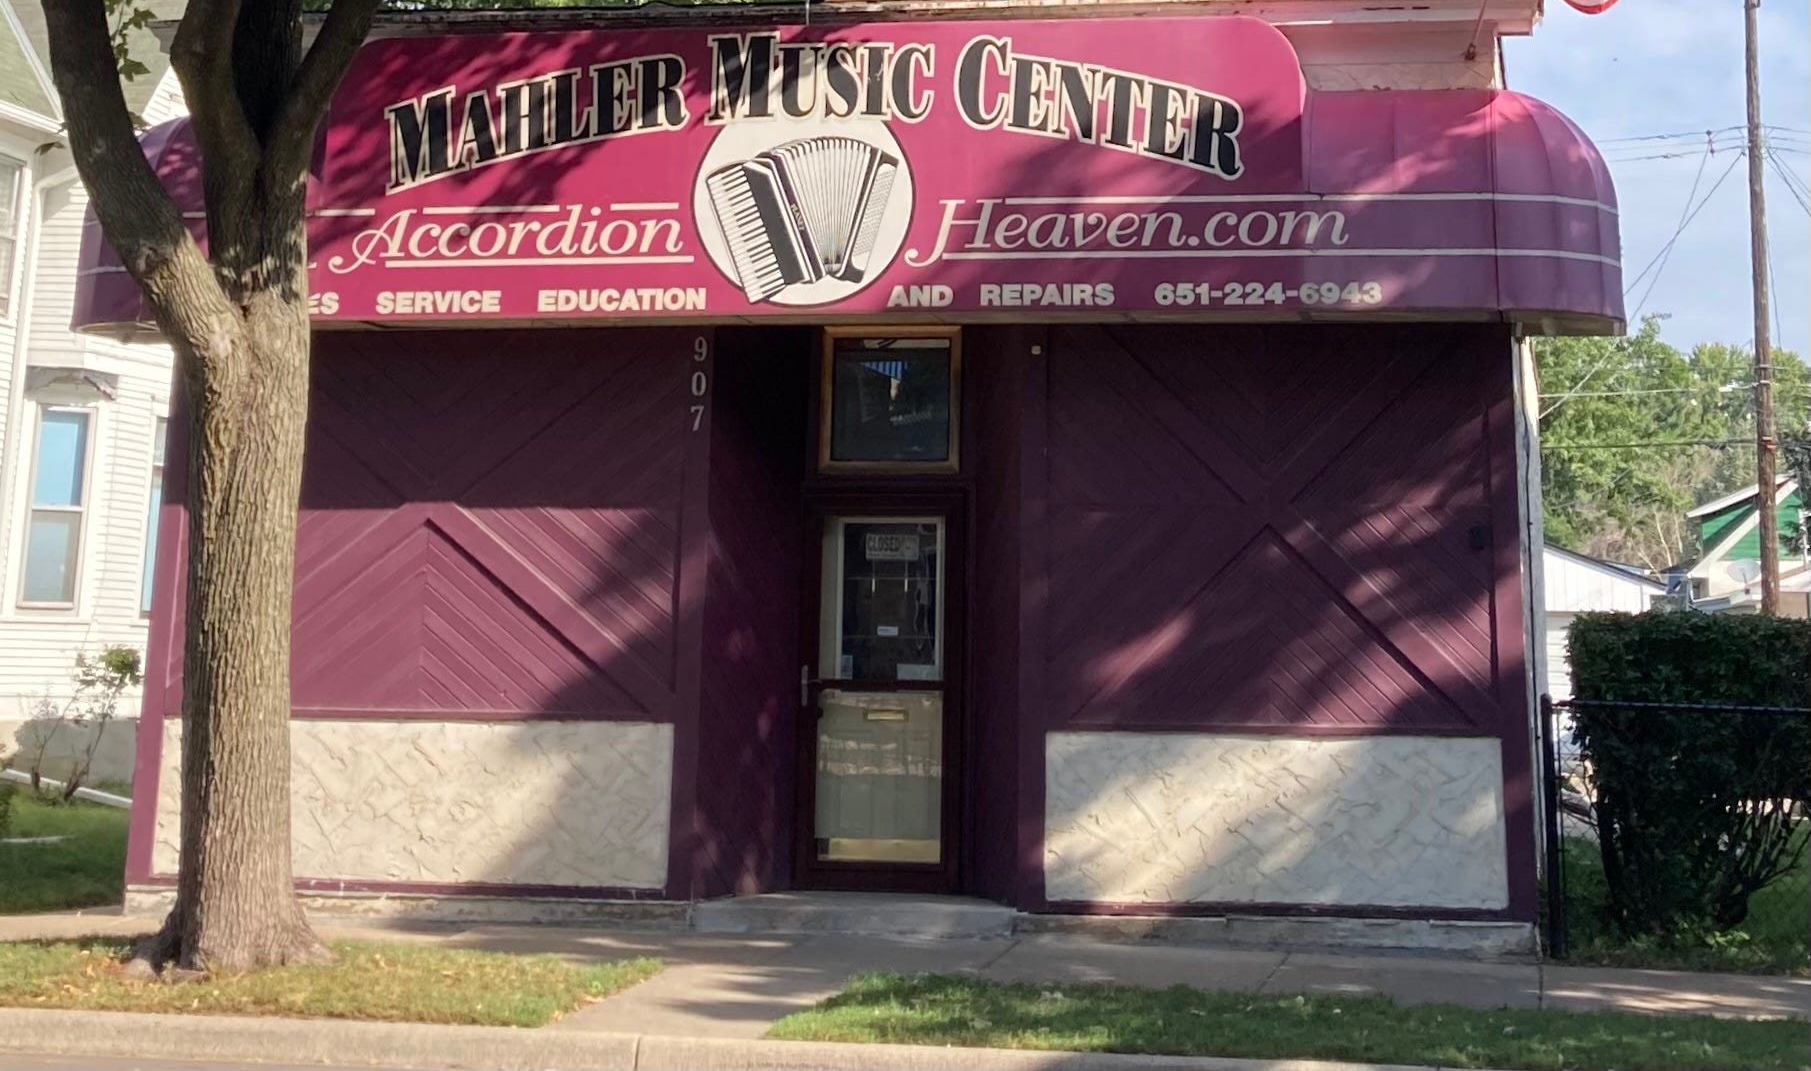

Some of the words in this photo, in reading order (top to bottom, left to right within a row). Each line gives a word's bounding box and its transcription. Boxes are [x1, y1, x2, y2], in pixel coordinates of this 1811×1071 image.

[385, 53, 690, 195] MAHLER
[704, 31, 935, 125] MUSIC
[953, 34, 1246, 181] CENTER
[328, 205, 684, 274] Accordion
[904, 198, 1349, 267] Heaven.com
[375, 290, 502, 315] SERVICE
[537, 287, 706, 313] EDUCATION
[887, 284, 954, 307] AND
[980, 283, 1116, 306] REPAIRS
[1154, 281, 1384, 305] 651-224-6943
